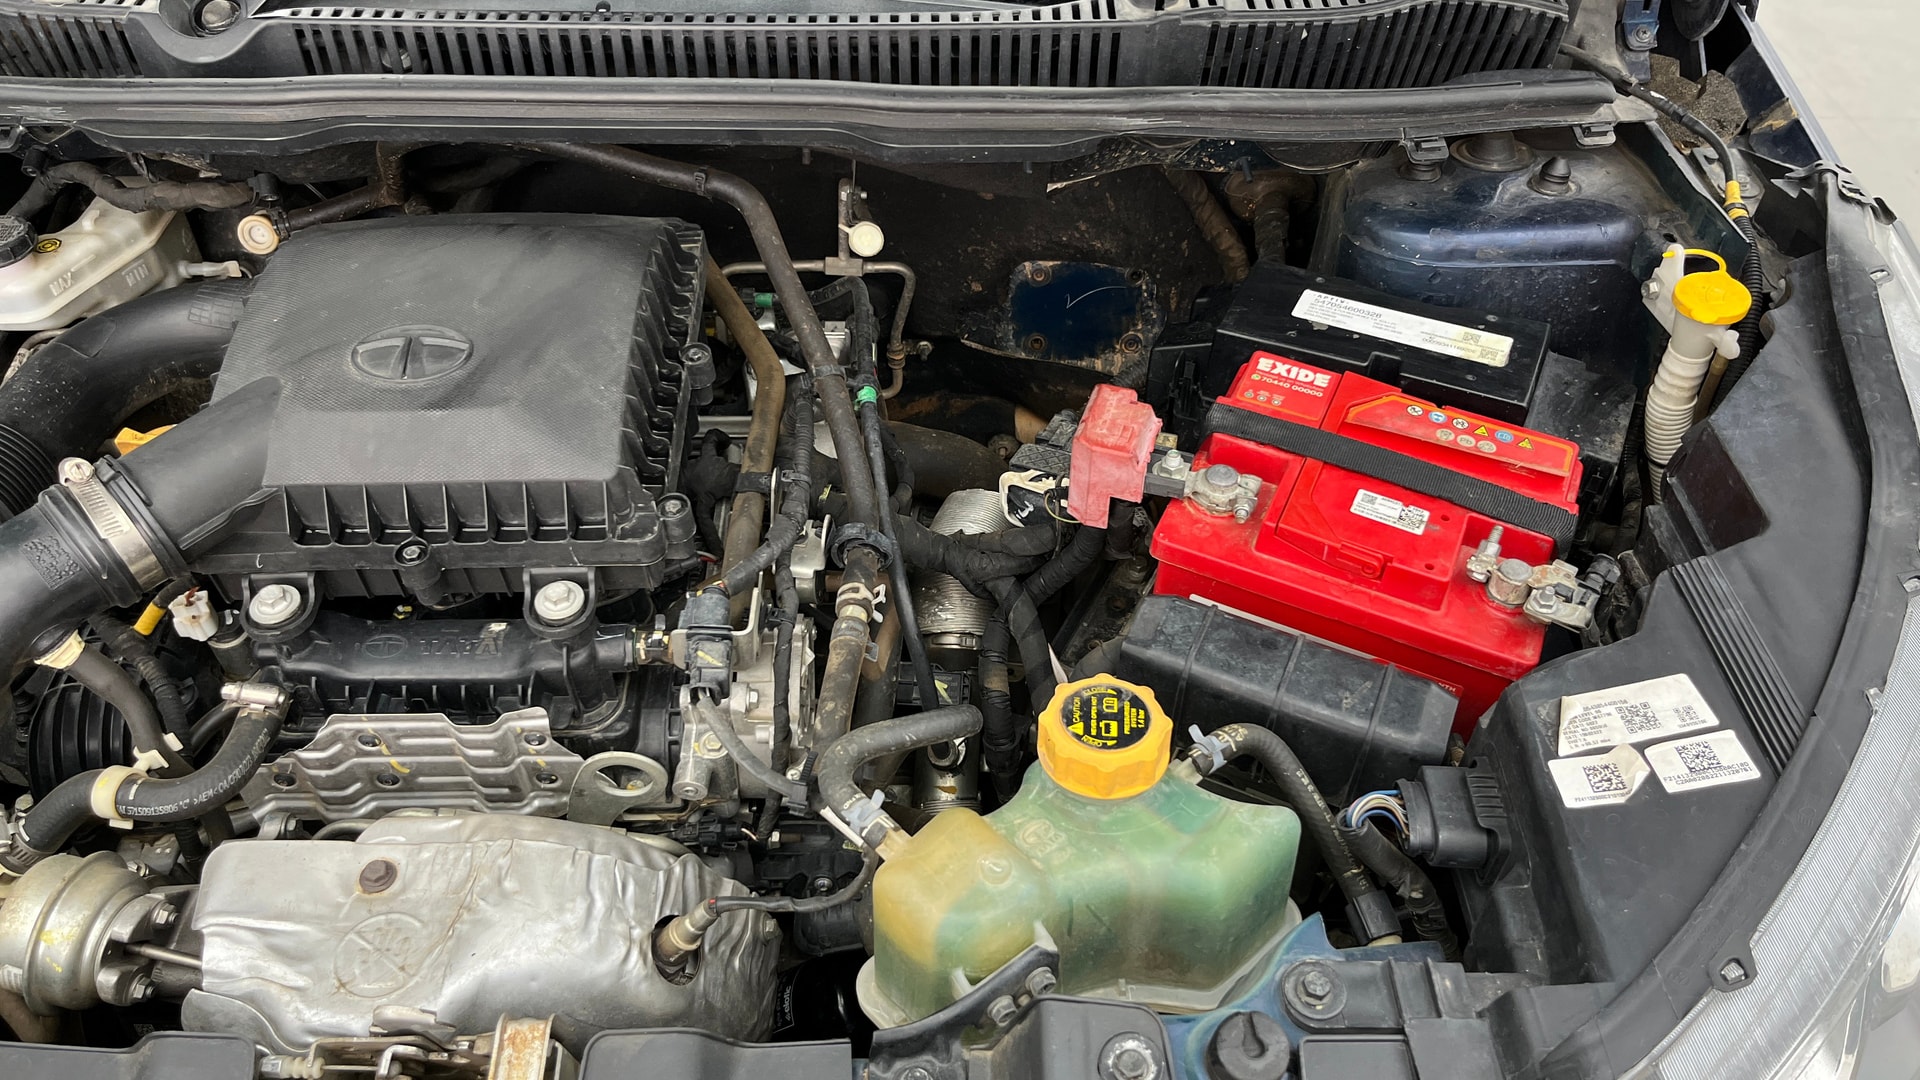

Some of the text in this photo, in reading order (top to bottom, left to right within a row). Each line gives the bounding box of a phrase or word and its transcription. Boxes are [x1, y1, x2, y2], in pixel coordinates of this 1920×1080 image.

[50, 271, 74, 297] MAX
[125, 264, 149, 287] MIN
[1256, 357, 1332, 388] EXIDE
[1261, 376, 1291, 389] 70440
[1291, 384, 1324, 398] 00000
[1072, 696, 1081, 723] CAUTION
[1137, 708, 1145, 719] bar
[1081, 734, 1103, 748] OPEN
